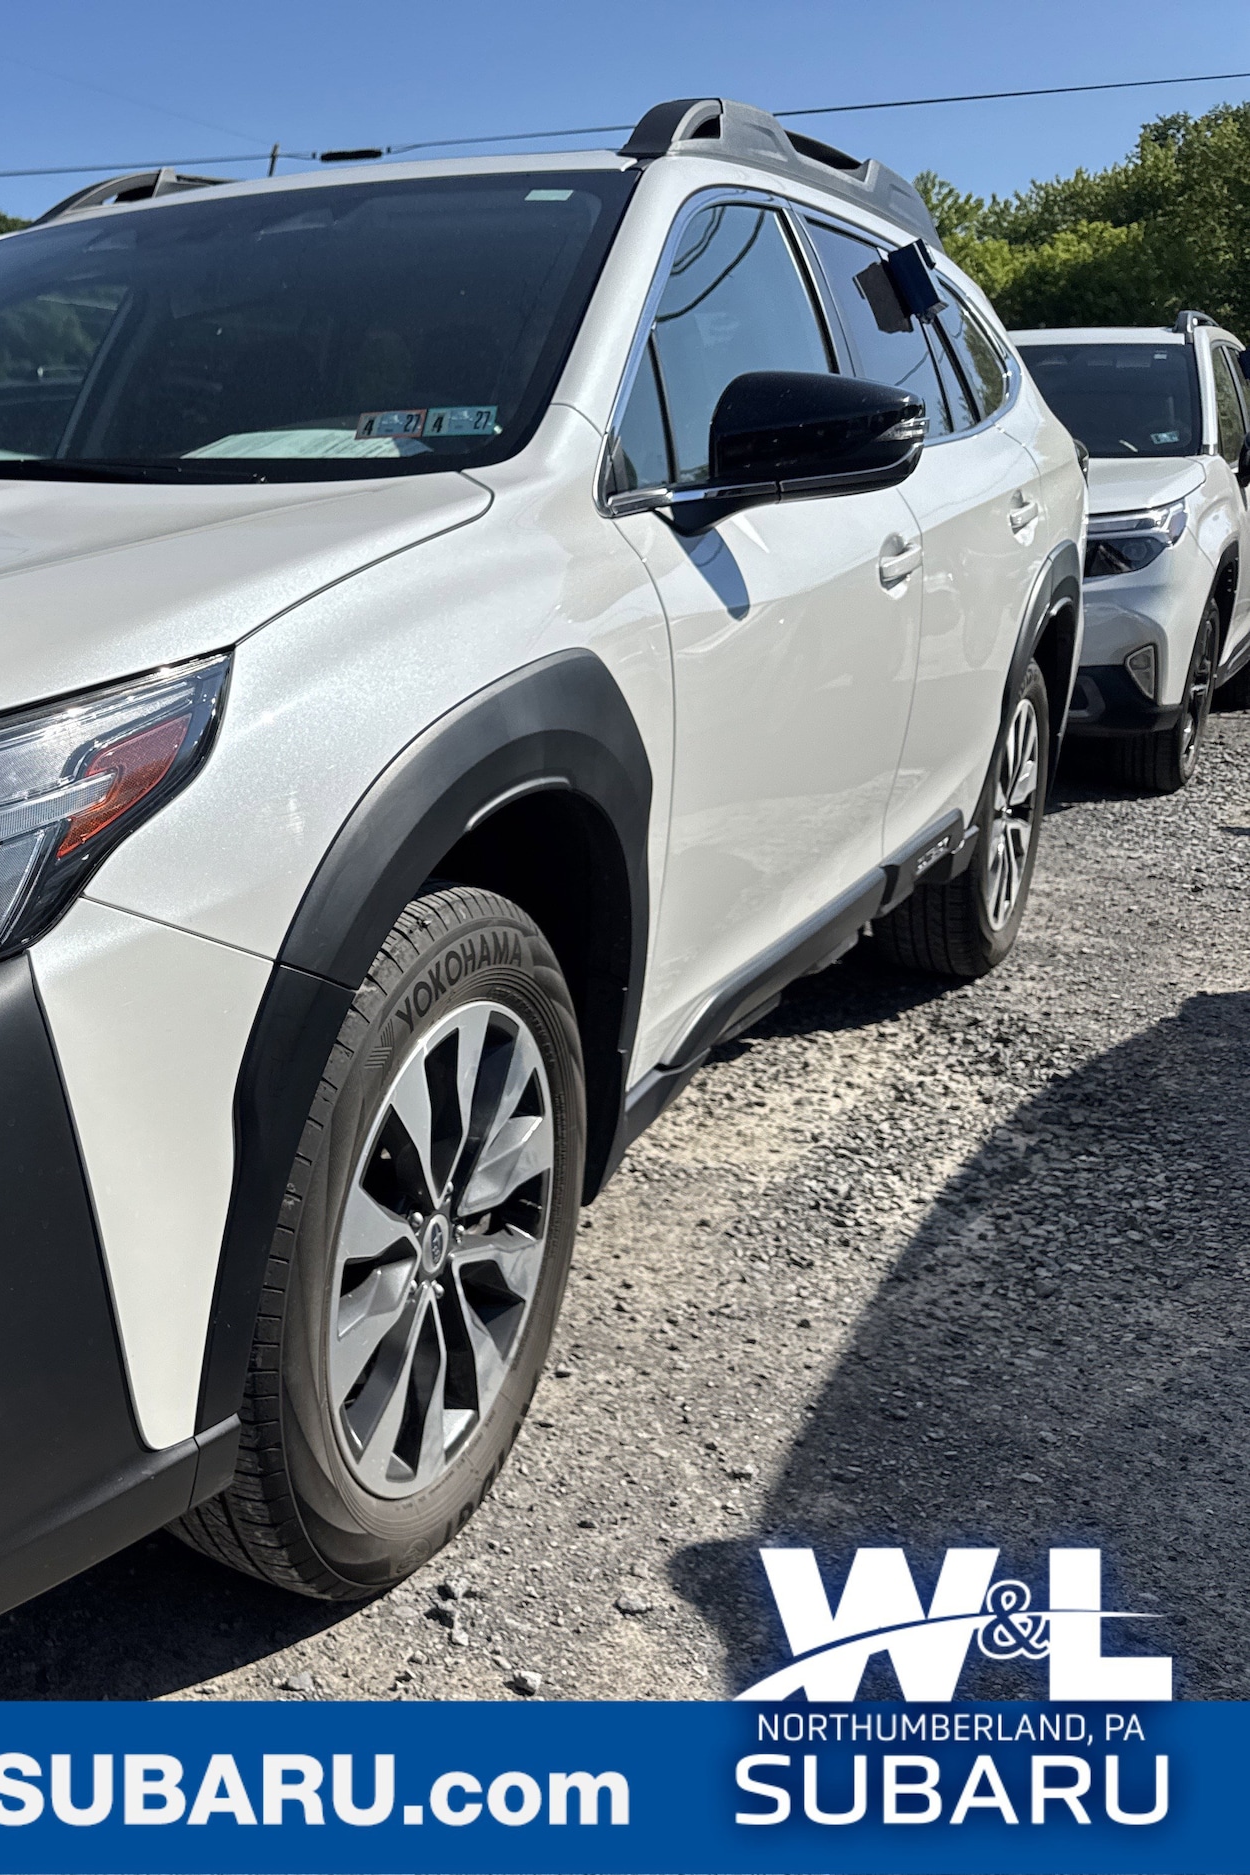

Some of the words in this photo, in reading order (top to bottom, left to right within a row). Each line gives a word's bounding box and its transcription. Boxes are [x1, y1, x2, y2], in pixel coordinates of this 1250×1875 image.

[364, 419, 375, 435] 4
[404, 414, 421, 432] 27
[433, 415, 444, 433] 4
[474, 411, 491, 430] 27
[395, 930, 523, 1034] YOKOHAMA
